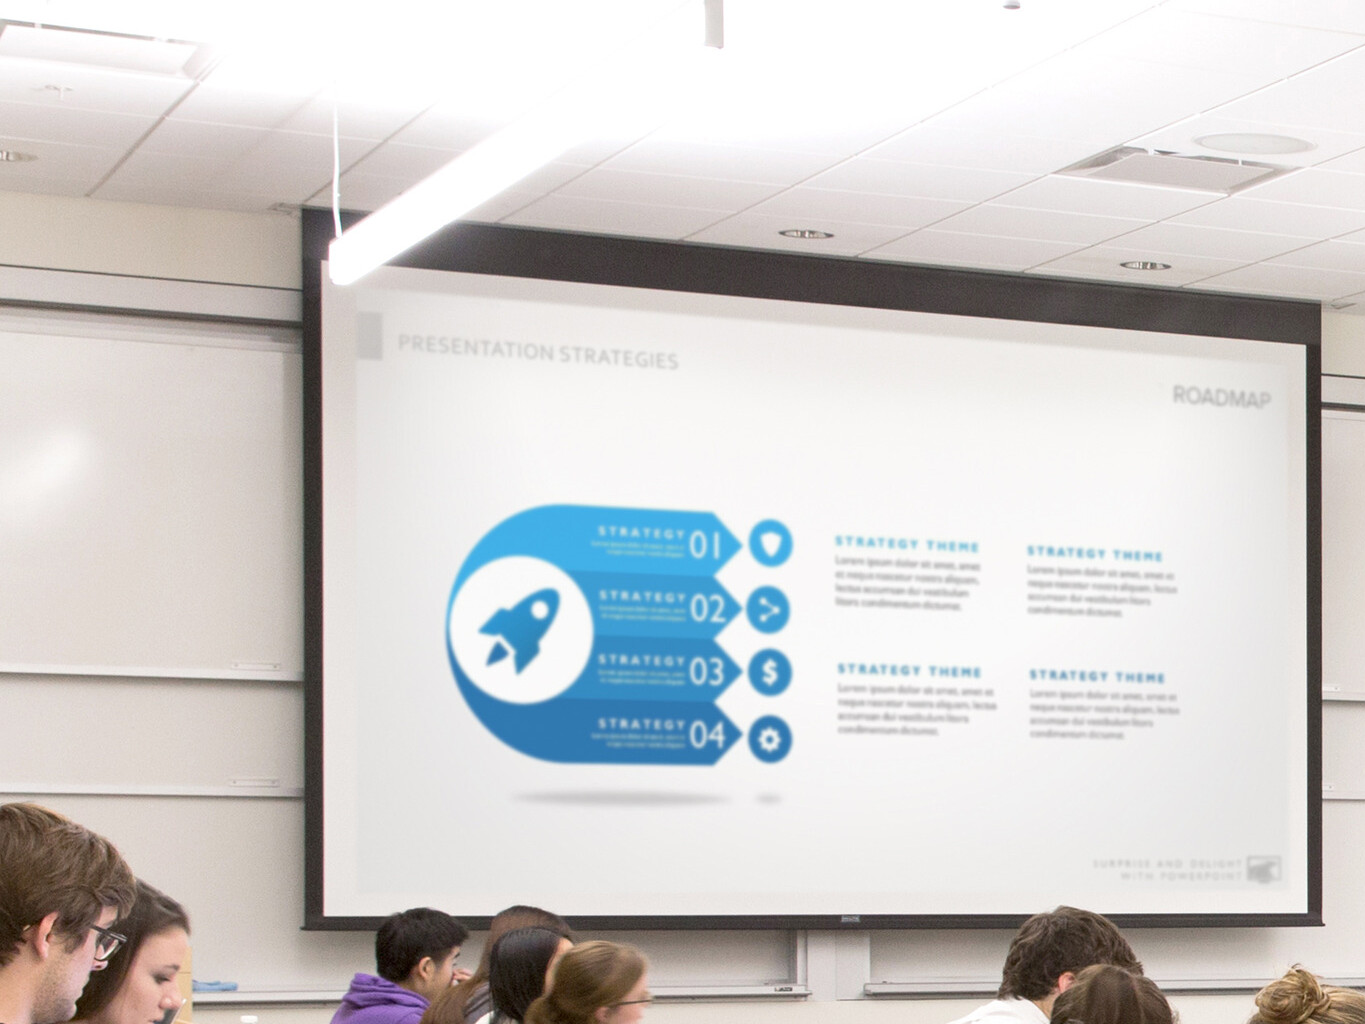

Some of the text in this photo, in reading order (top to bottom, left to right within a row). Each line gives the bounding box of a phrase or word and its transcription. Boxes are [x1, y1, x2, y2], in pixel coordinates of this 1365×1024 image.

[399, 334, 679, 370] PRESENTATION STRATEGIES
[1173, 385, 1272, 410] ROADMAP
[598, 526, 685, 539] STRATEGY
[689, 530, 720, 560] 01
[835, 535, 979, 553] STRATEGY THEME
[1027, 545, 1163, 562] STRATEGY THEME
[599, 590, 686, 603] STRATEGY
[690, 594, 726, 623] 02
[598, 654, 685, 667] STRATEGY
[690, 657, 724, 686] 03
[762, 658, 778, 687] $
[838, 663, 981, 678] STRATEGY THEME
[1029, 669, 1166, 684] STRATEGY THEME
[598, 718, 685, 731] STRATEGY
[690, 720, 726, 749] 04
